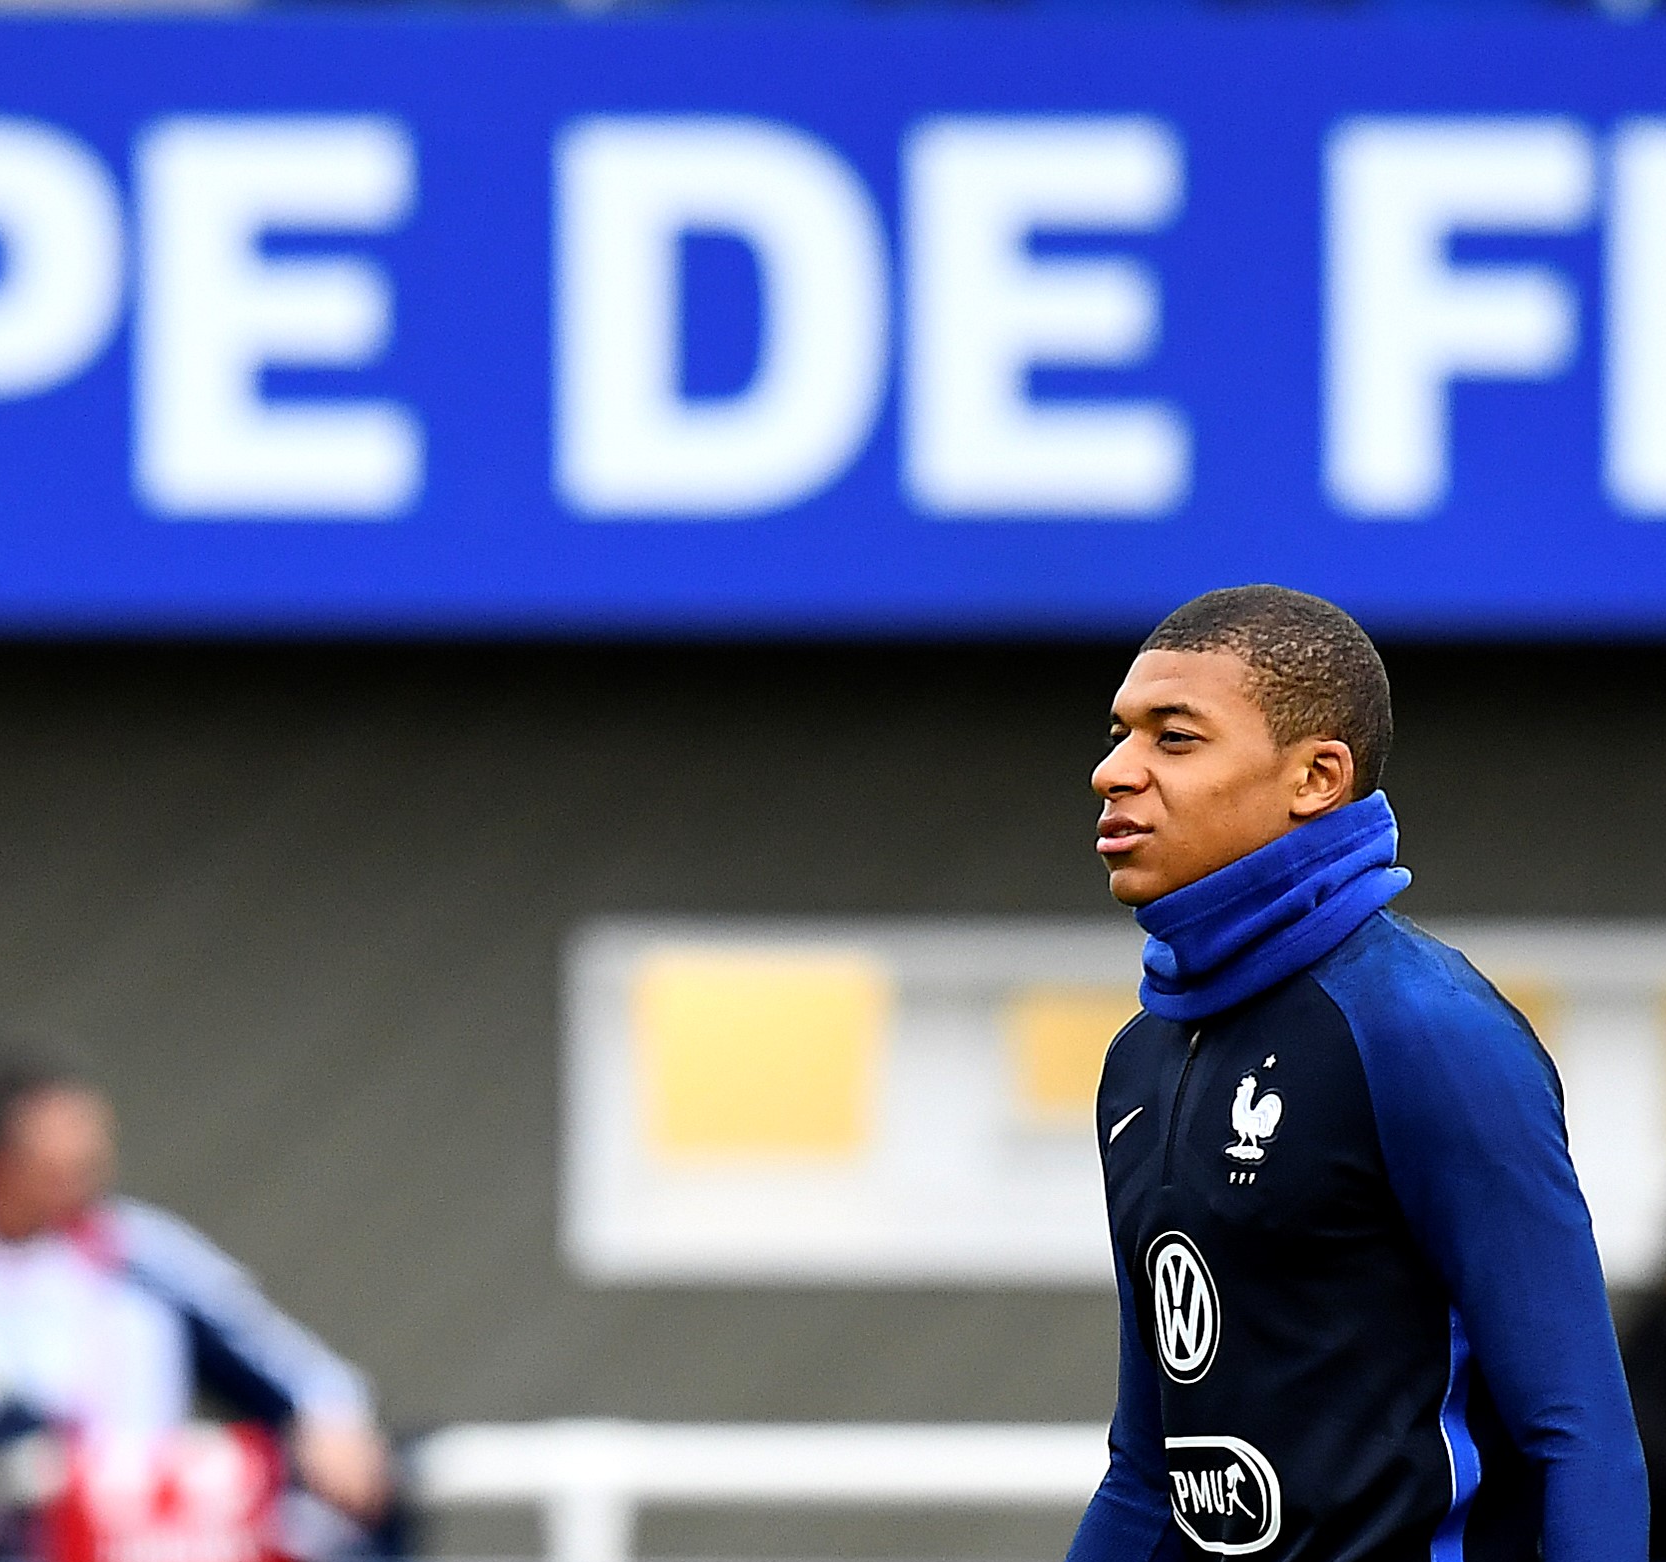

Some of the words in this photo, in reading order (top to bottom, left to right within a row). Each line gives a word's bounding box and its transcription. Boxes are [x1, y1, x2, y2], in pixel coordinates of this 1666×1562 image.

[553, 116, 1190, 518] DE
[1229, 1171, 1256, 1185] FFF
[1169, 1469, 1226, 1514] PMU
